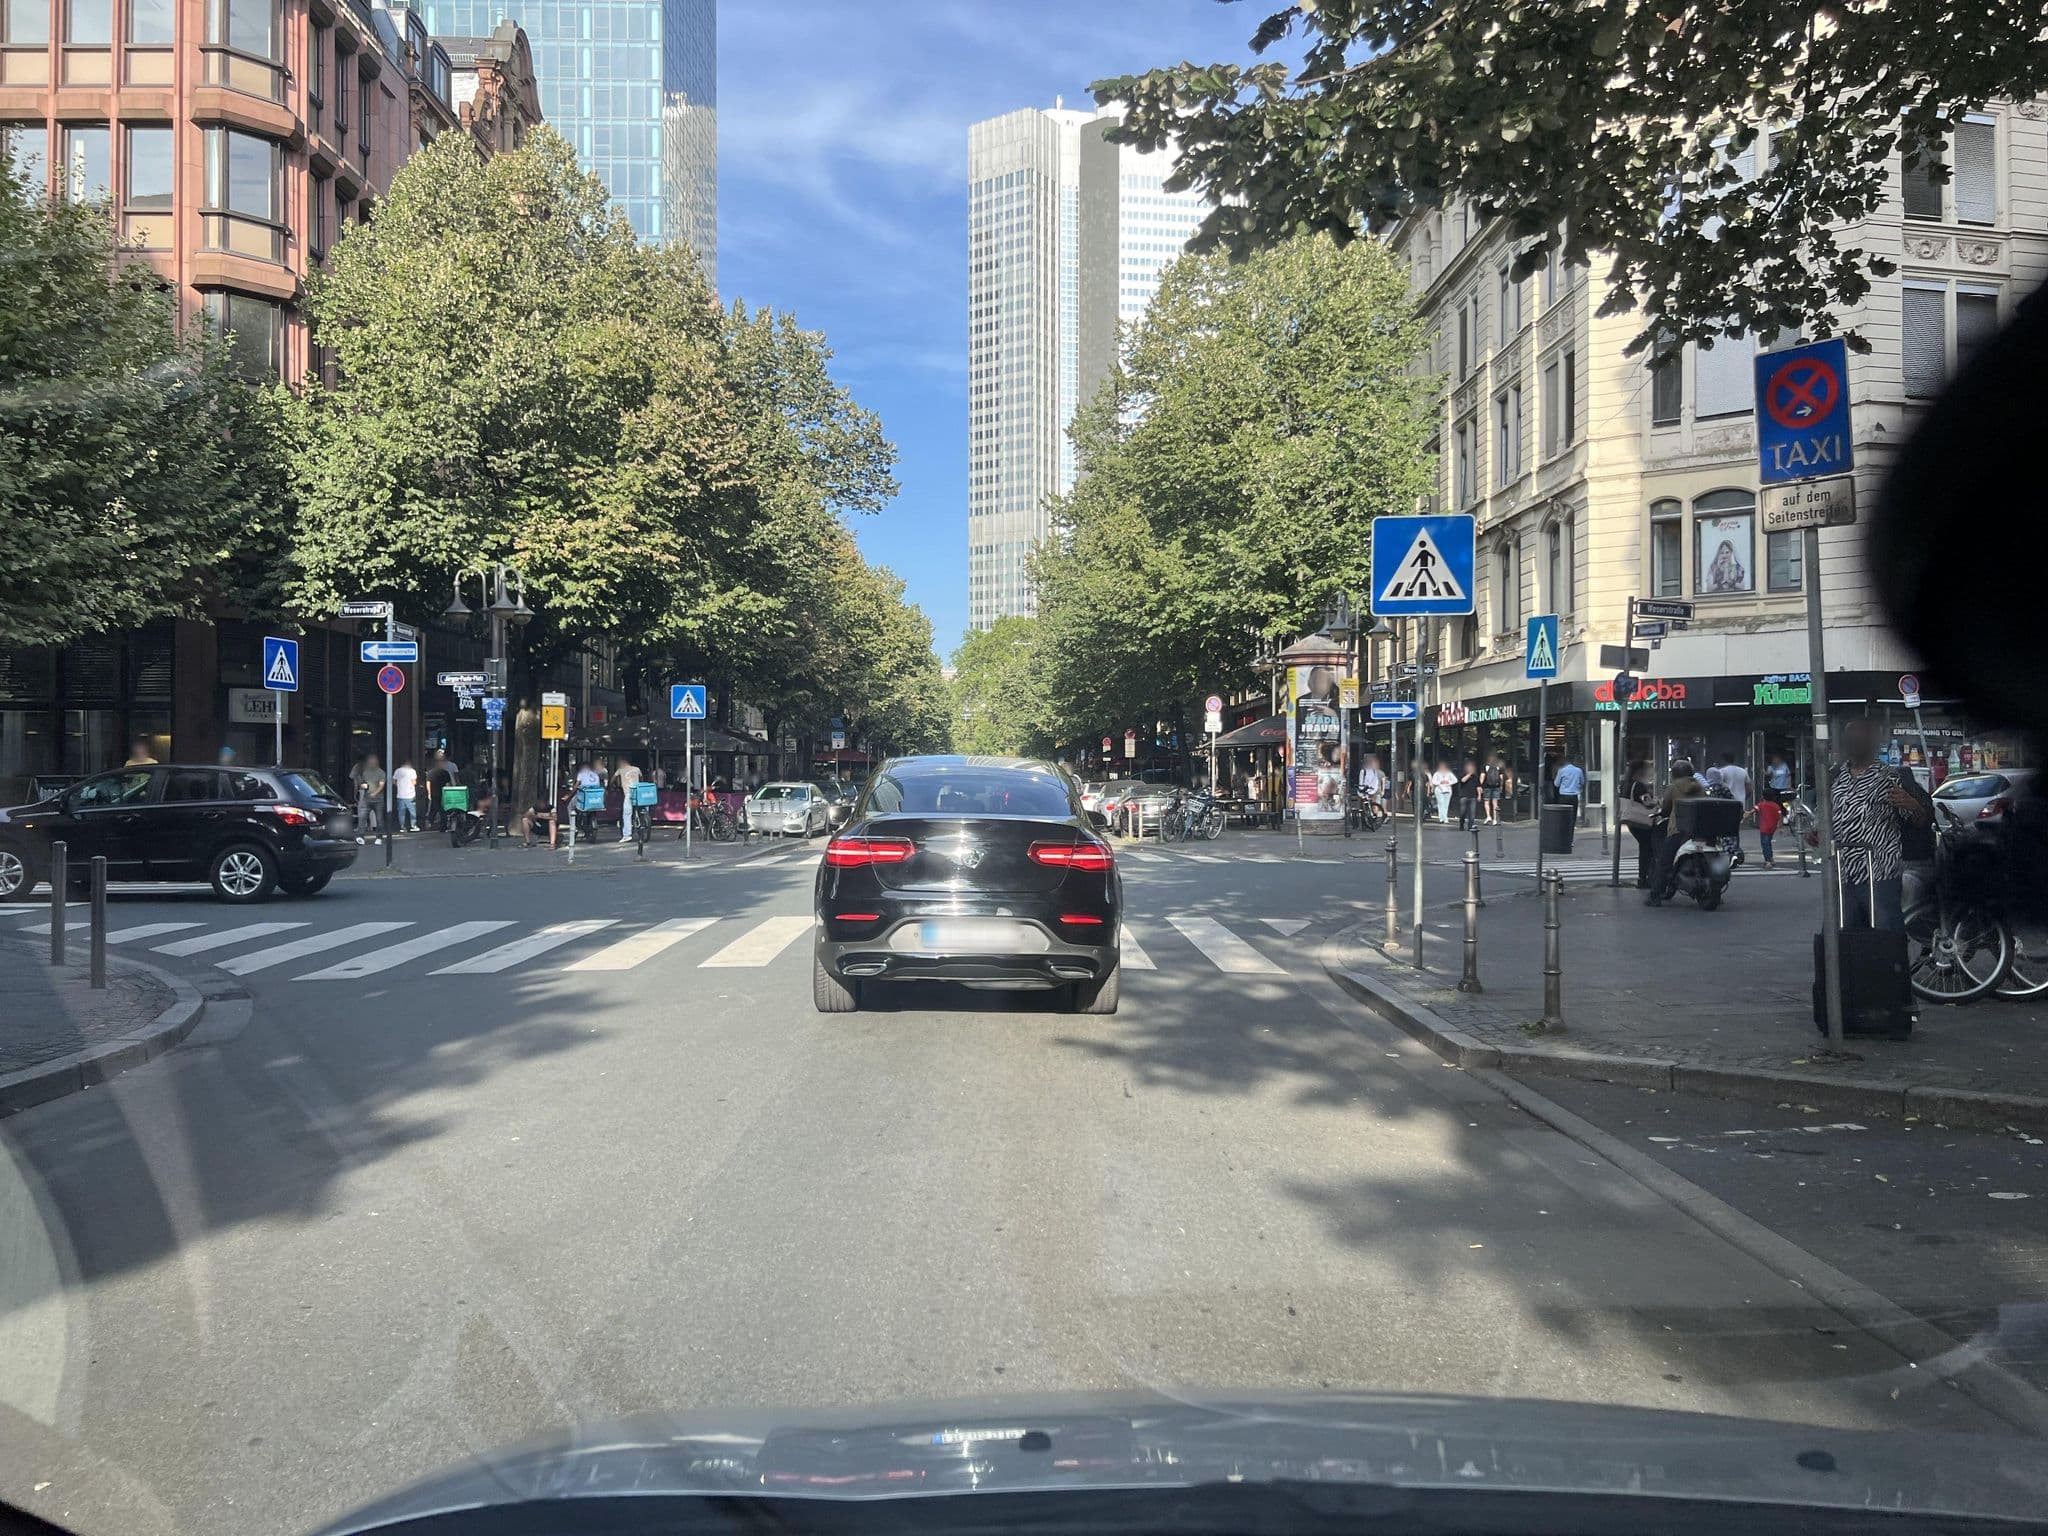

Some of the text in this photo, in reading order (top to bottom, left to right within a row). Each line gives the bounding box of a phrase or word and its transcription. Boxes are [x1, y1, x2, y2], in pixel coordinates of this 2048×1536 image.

[1768, 434, 1841, 470] TAXI
[1782, 490, 1831, 506] auf dem
[1788, 674, 1811, 682] BASA
[244, 701, 277, 713] LEH
